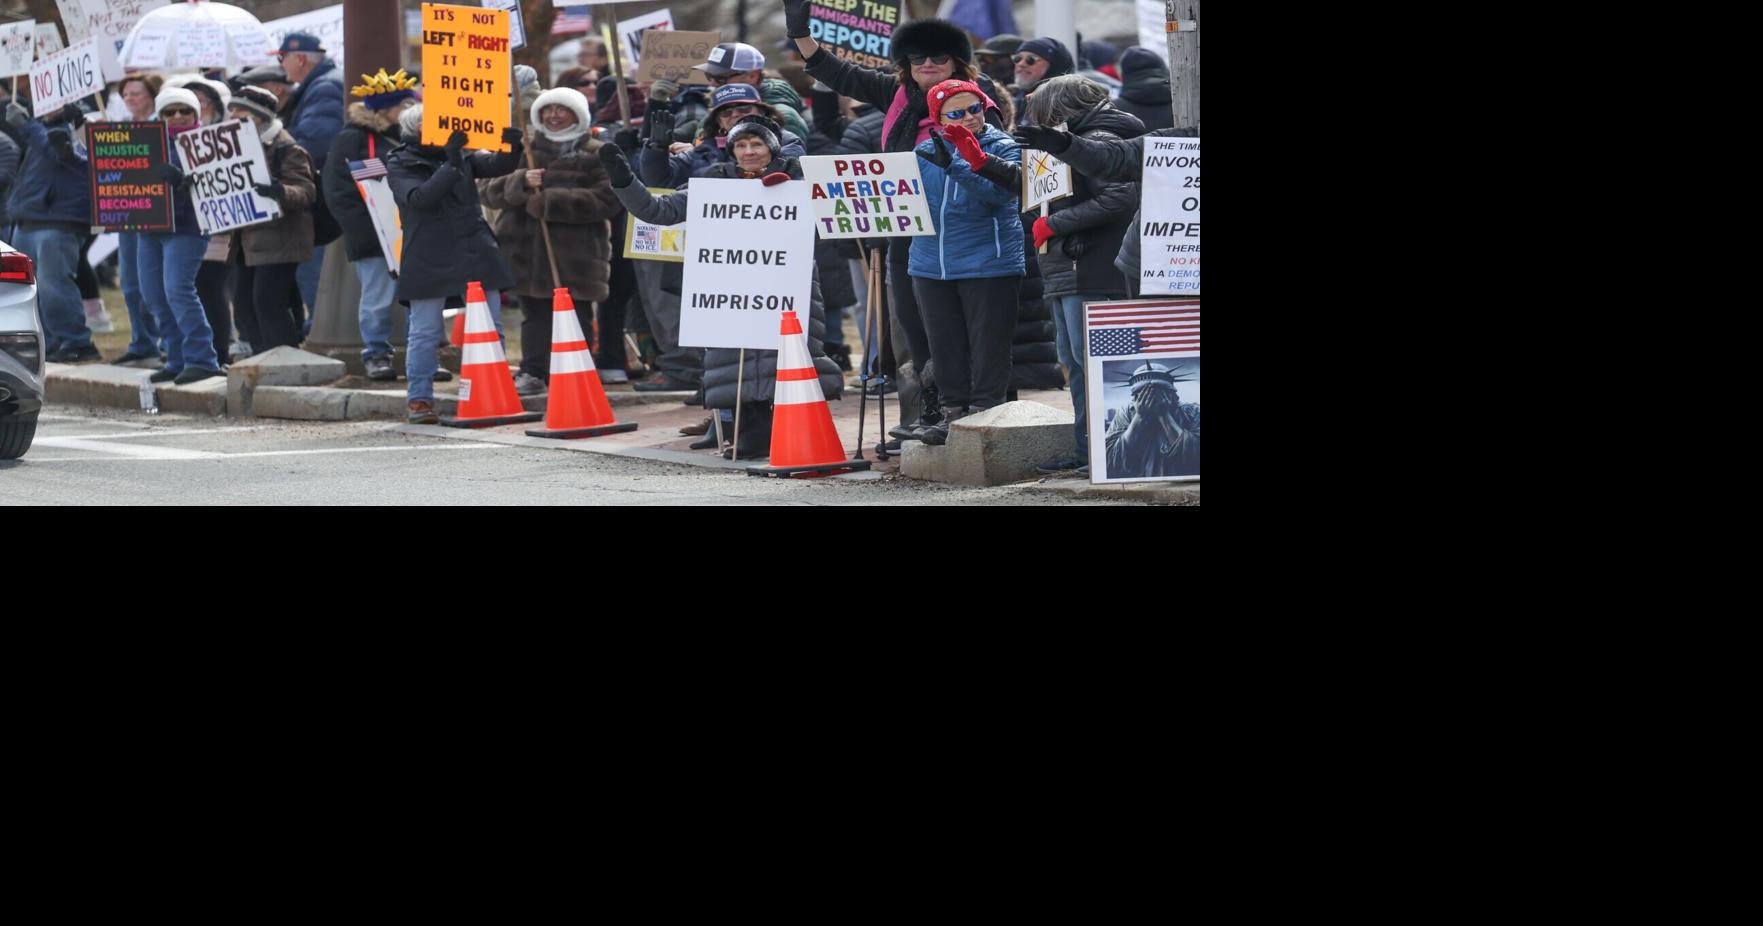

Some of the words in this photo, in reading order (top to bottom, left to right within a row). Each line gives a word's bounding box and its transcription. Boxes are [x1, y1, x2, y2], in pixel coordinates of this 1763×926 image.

[433, 9, 455, 21] IT'S
[472, 13, 495, 25] NOT
[863, 1, 896, 23] THE
[423, 30, 455, 47] LEFT
[468, 34, 508, 53] RIGHT
[810, 18, 891, 57] DEPORT
[443, 54, 457, 66] IT
[476, 58, 492, 69] IS
[34, 70, 53, 102] NO
[441, 75, 494, 94] RIGHT
[457, 96, 474, 108] OR
[438, 115, 494, 134] WRONG
[95, 131, 130, 143] WHEN
[96, 144, 150, 156] INJUSTICE
[179, 122, 242, 170] RESIST
[1154, 142, 1175, 150] THE
[96, 158, 150, 169] BECOMES
[835, 159, 885, 176] PRO
[98, 172, 122, 183] LAW
[191, 160, 254, 200] PERSIST
[1033, 172, 1059, 200] KINGS
[98, 184, 165, 197] RESISTANCE
[812, 179, 920, 199] AMERICA!
[100, 198, 152, 210] BECOMES
[200, 191, 268, 232] PREVAIL
[702, 203, 798, 221] IMPEACH
[835, 197, 909, 214] ANTI-
[100, 211, 129, 224] DUTY
[821, 215, 924, 234] TRUMP!
[698, 248, 787, 266] REMOVE
[1169, 257, 1186, 266] NO
[1143, 270, 1155, 278] IN
[1157, 270, 1165, 278] A
[692, 293, 795, 311] IMPRISON
